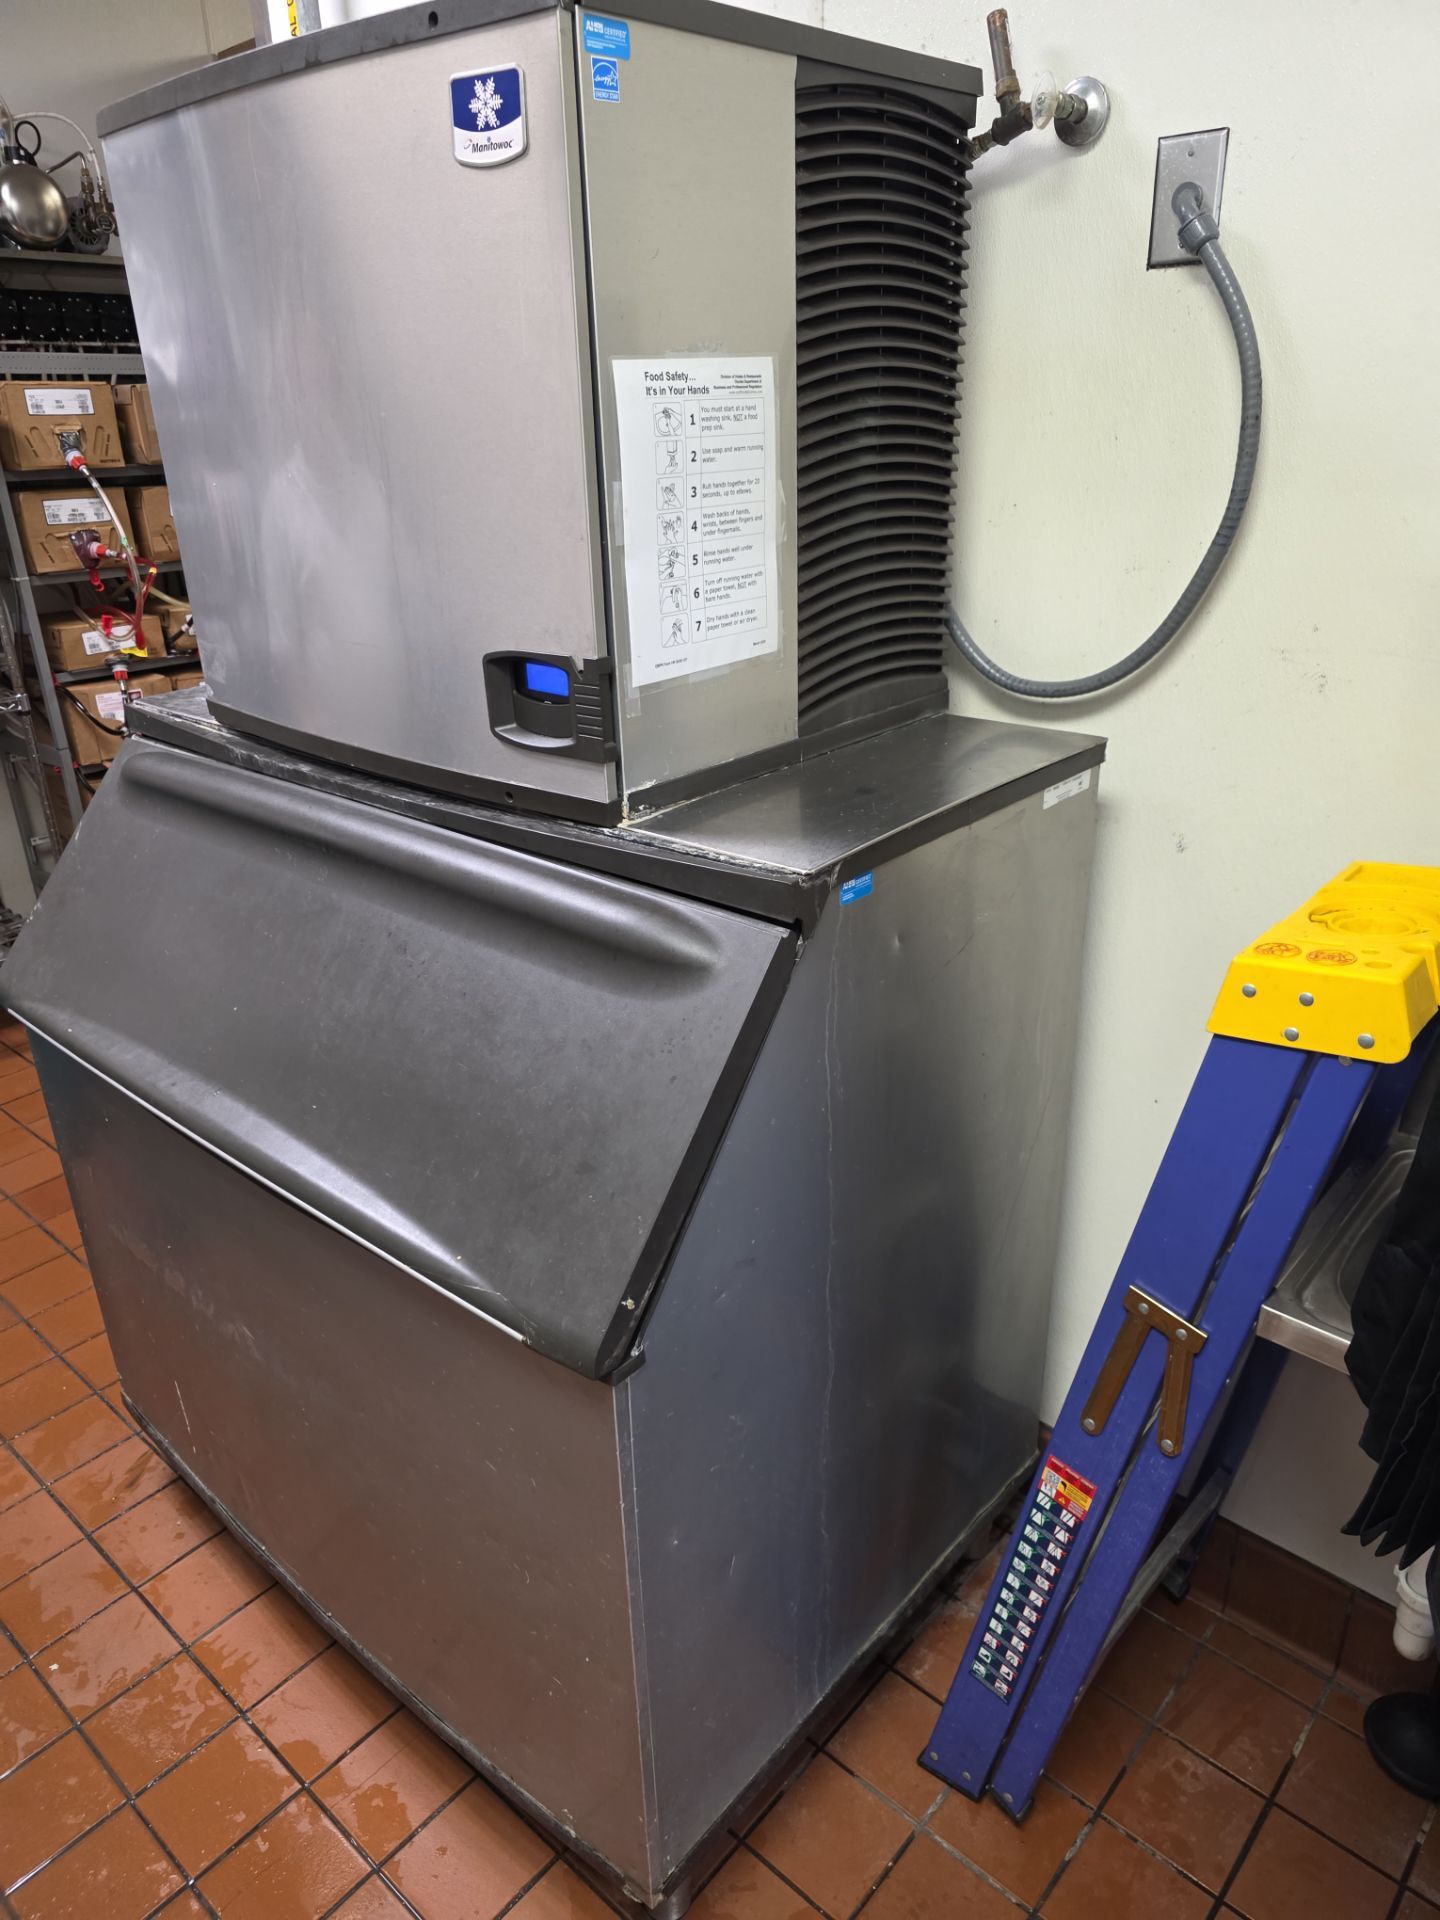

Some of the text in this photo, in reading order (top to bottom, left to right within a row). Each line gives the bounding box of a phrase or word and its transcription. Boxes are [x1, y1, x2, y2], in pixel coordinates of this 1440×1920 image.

[472, 138, 513, 153] Manitowoc
[645, 371, 664, 382] Food
[646, 385, 710, 396] It's in Your Hands
[690, 414, 696, 425] 1
[691, 451, 696, 462] 2
[691, 486, 697, 498] 3
[691, 521, 697, 531] 4
[692, 554, 698, 565] 5
[694, 588, 700, 598] 6
[696, 621, 701, 631] 7
